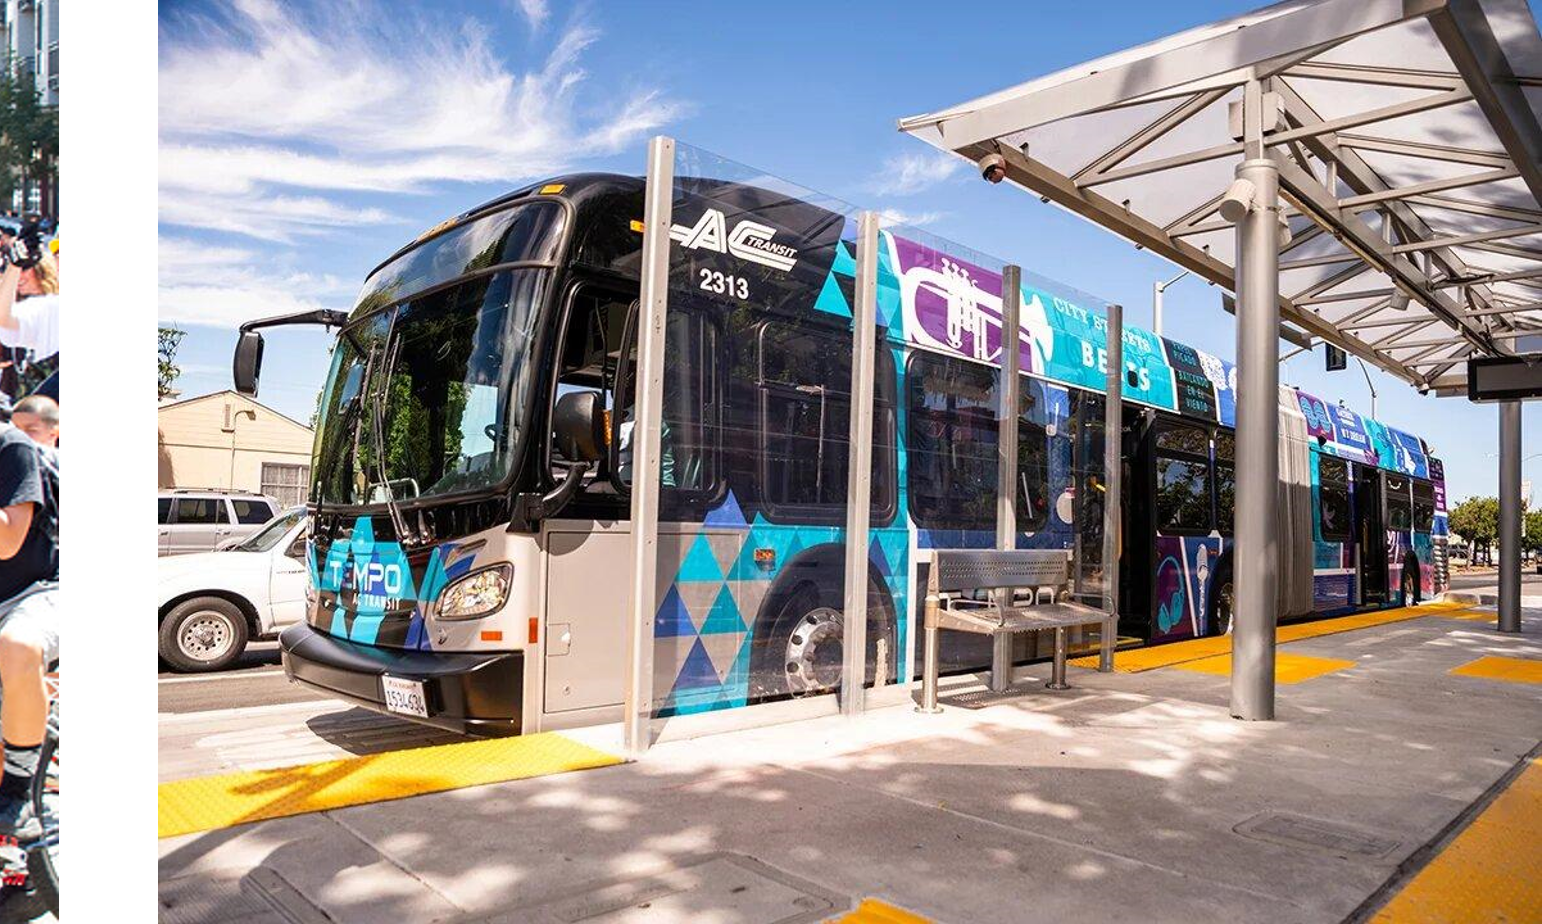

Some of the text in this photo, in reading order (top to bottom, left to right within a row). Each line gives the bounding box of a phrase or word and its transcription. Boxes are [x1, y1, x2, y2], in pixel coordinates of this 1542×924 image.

[747, 236, 798, 258] TRANSIT
[699, 267, 749, 300] 2313
[1053, 297, 1089, 324] CITY
[329, 560, 401, 594] TEMPO
[364, 594, 401, 611] TRANSIT
